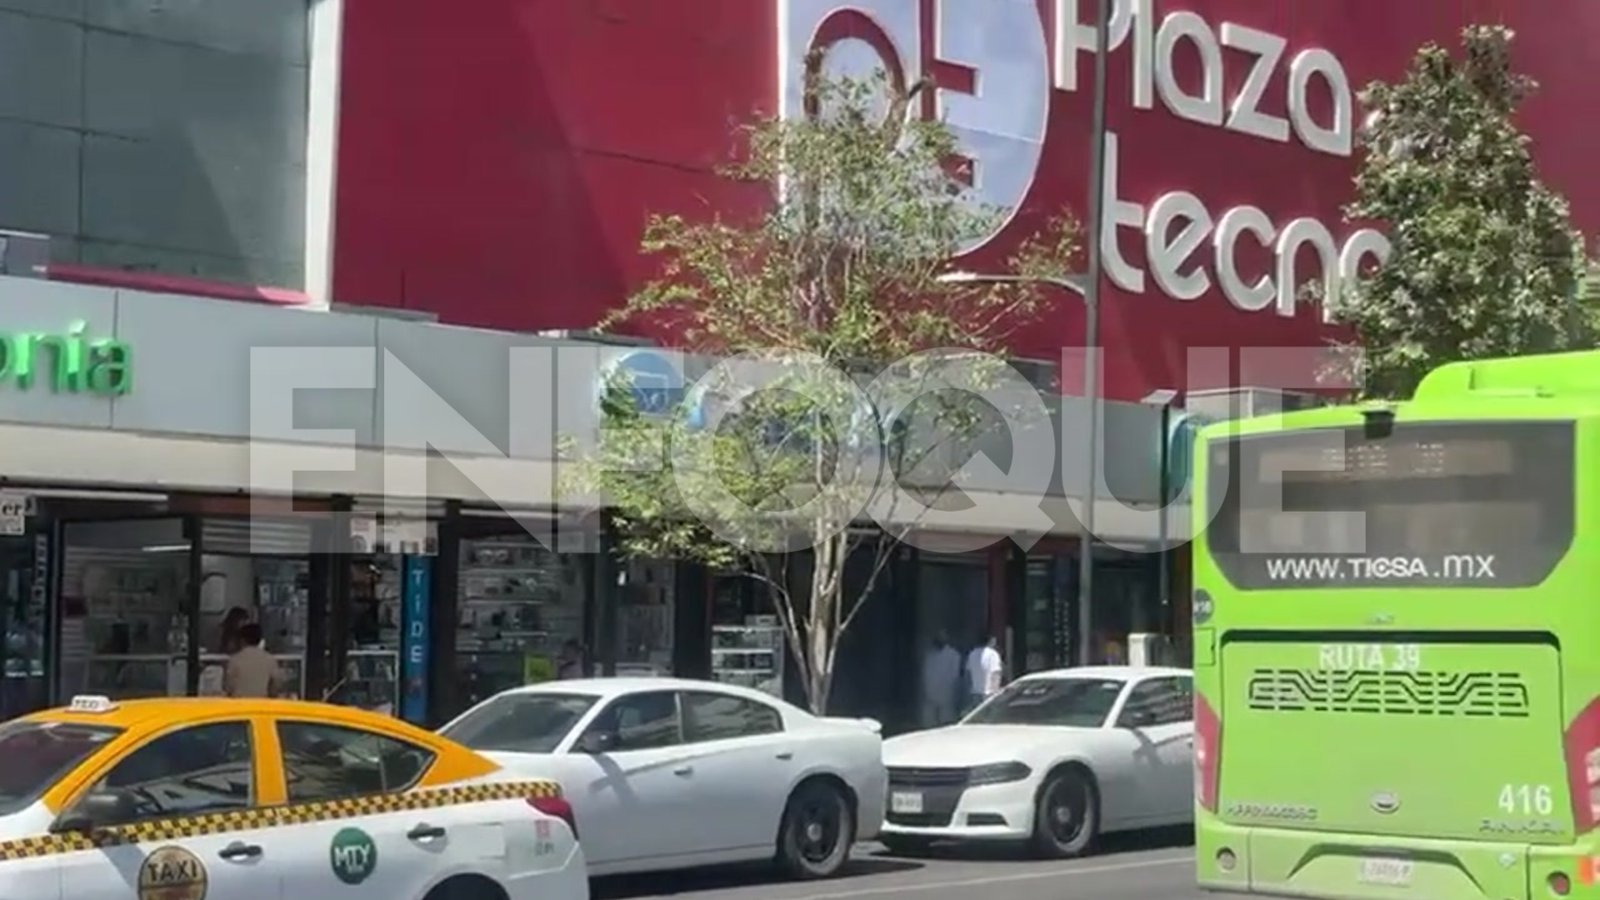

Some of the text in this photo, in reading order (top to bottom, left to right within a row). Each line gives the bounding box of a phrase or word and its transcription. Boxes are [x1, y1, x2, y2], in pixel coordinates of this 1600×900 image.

[1054, 0, 1352, 156] Plaza
[1319, 643, 1421, 670] RUTA 39
[73, 698, 99, 709] TAXI
[1498, 783, 1554, 815] 416
[334, 842, 371, 867] MTY
[147, 860, 198, 881] TAXI
